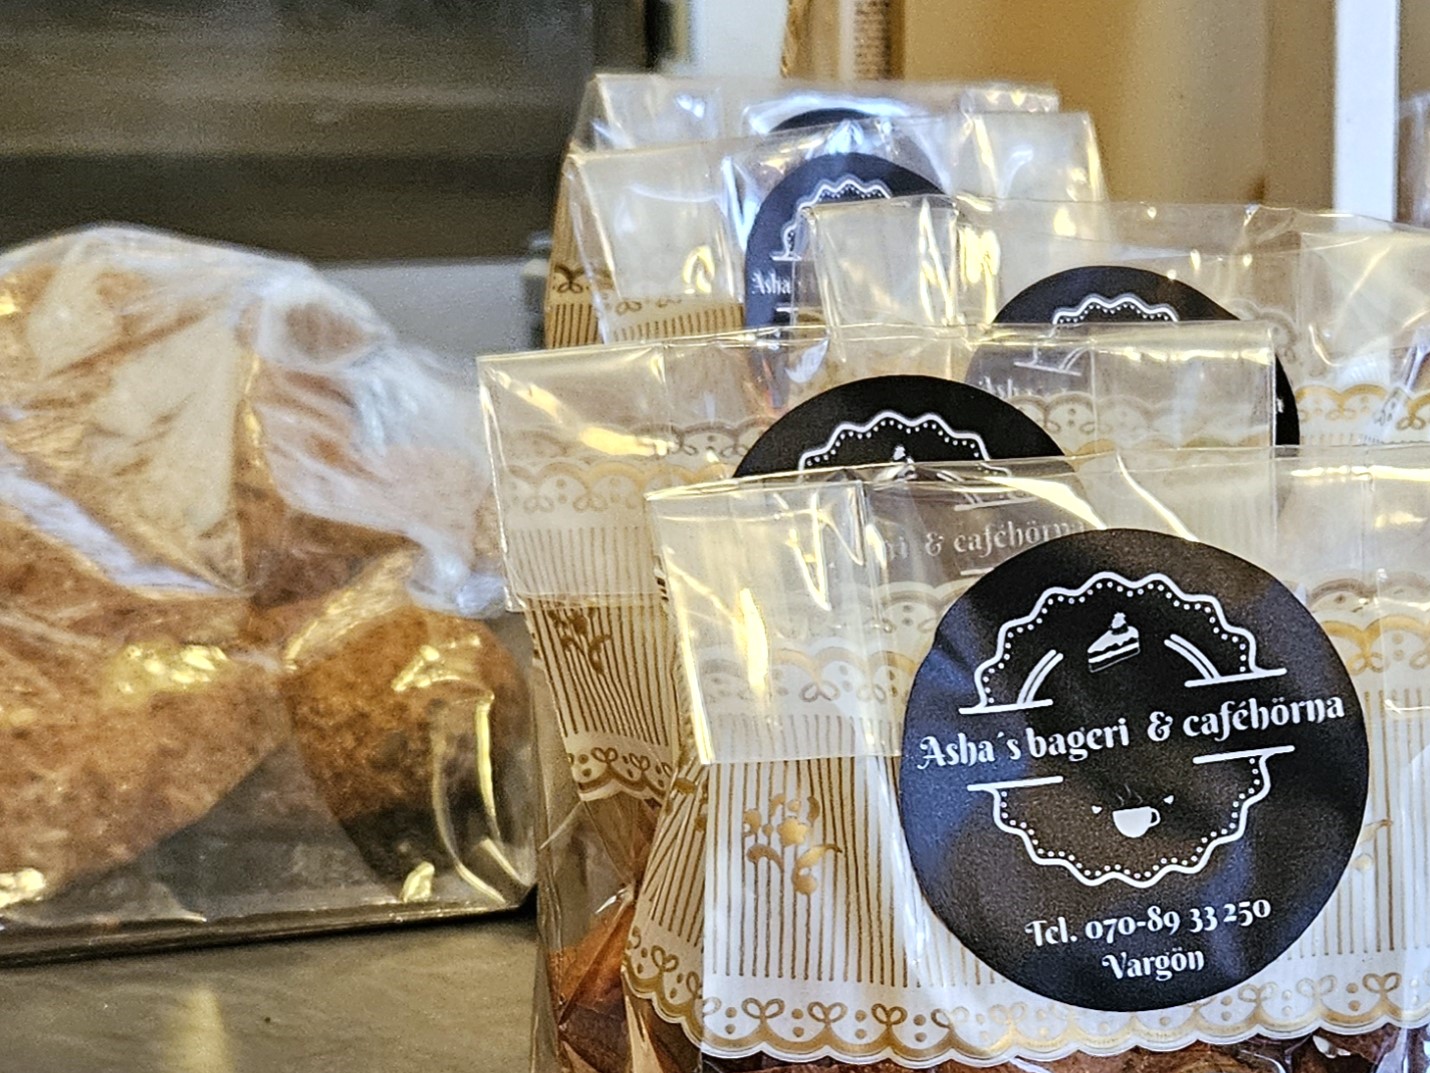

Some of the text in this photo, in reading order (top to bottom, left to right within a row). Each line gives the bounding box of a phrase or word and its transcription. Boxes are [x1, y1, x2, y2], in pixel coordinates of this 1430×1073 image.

[751, 267, 802, 296] Asha
[924, 531, 945, 557] &
[1025, 717, 1131, 763] bageri
[1147, 711, 1174, 742] &
[1182, 696, 1346, 741] caféhörna
[1025, 916, 1078, 947] Tel.
[1085, 905, 1181, 944] 070-89
[1101, 946, 1206, 982] Vargön
